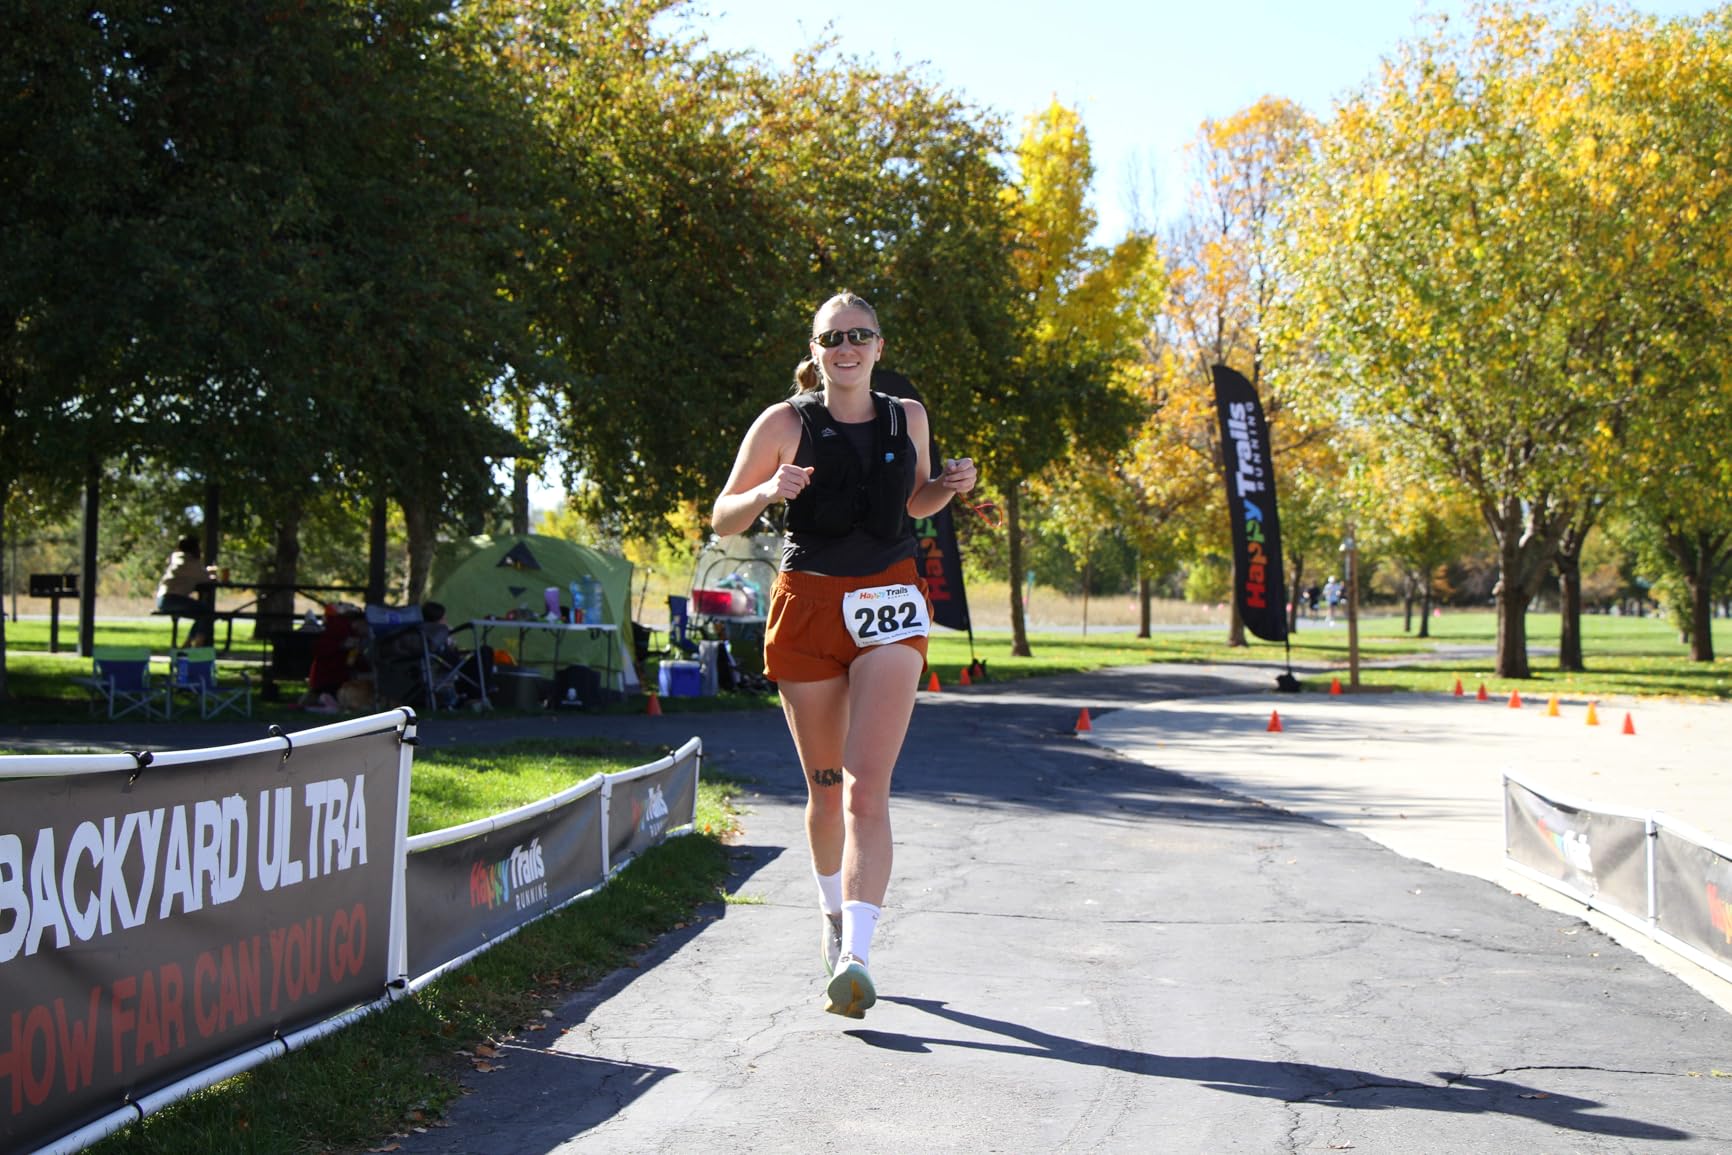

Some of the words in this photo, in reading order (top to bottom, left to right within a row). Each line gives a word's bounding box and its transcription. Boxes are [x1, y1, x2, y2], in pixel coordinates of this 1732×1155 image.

[1227, 402, 1258, 497] Trails
[1246, 401, 1266, 491] RUNNING
[886, 587, 908, 596] Trails
[1242, 498, 1268, 609] Happy
[854, 601, 922, 639] 282
[0, 793, 248, 963] BACKYARD
[258, 774, 368, 891] ULTRA
[510, 837, 545, 889] Trails
[515, 881, 548, 911] RUNNING
[111, 962, 185, 1073] FAR
[194, 936, 261, 1038] CAN
[269, 915, 323, 1012] YOU
[328, 903, 368, 983] GO
